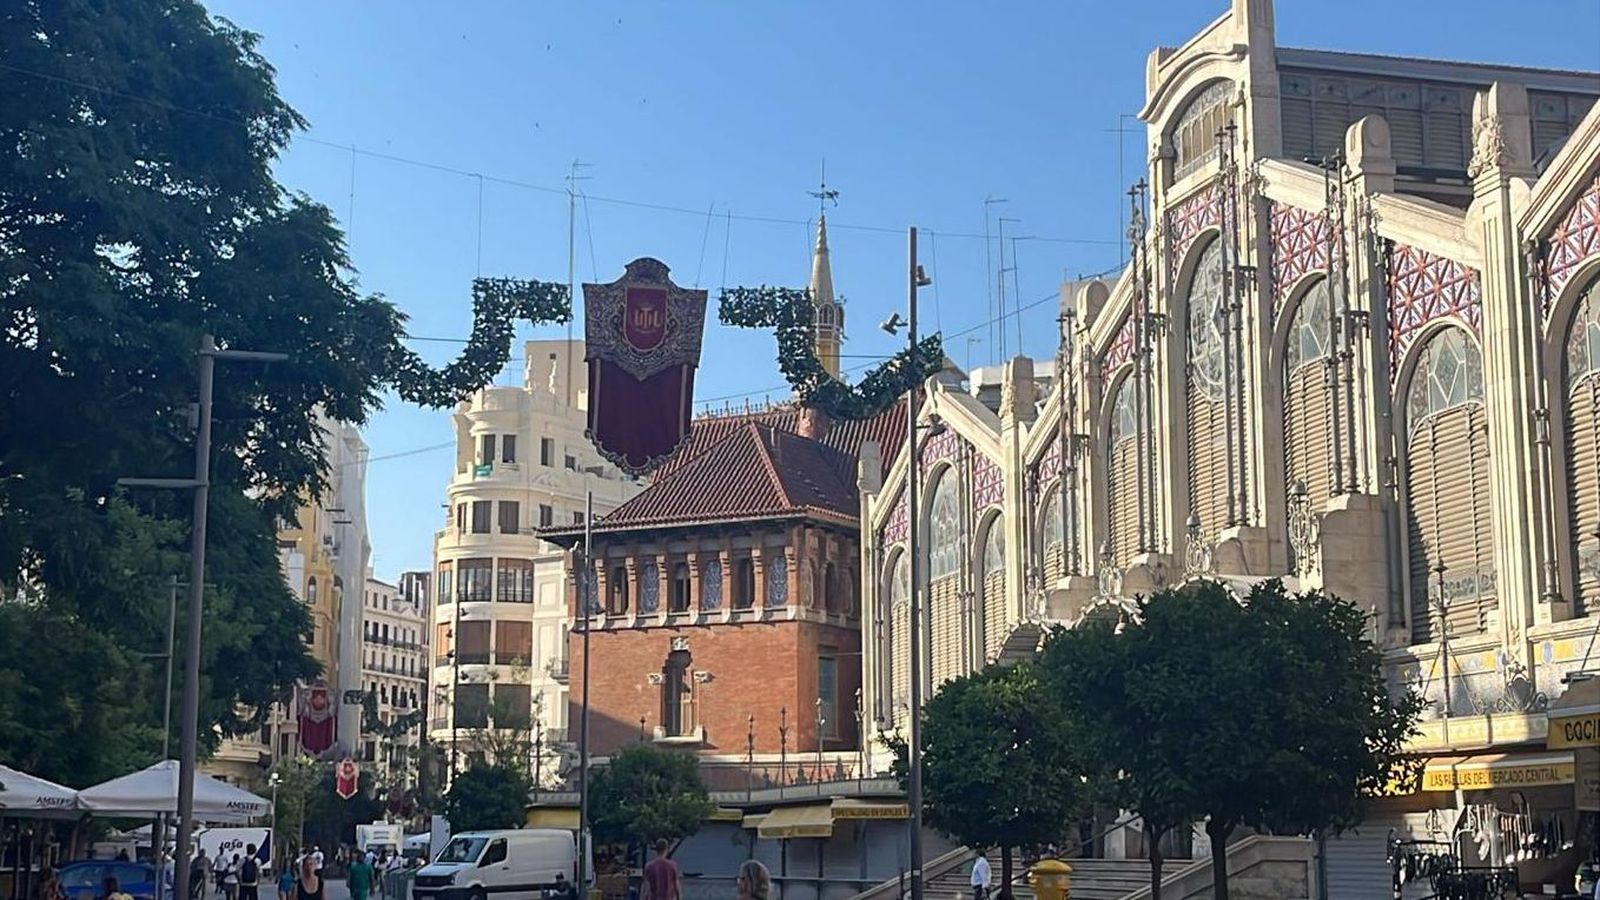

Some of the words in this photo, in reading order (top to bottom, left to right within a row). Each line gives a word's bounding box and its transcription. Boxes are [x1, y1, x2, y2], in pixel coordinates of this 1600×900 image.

[1564, 719, 1600, 741] COCI
[1430, 773, 1444, 786] LAS
[1474, 771, 1487, 785] DEL
[1488, 769, 1524, 784] MERCADO
[1526, 767, 1560, 781] CENTRAL
